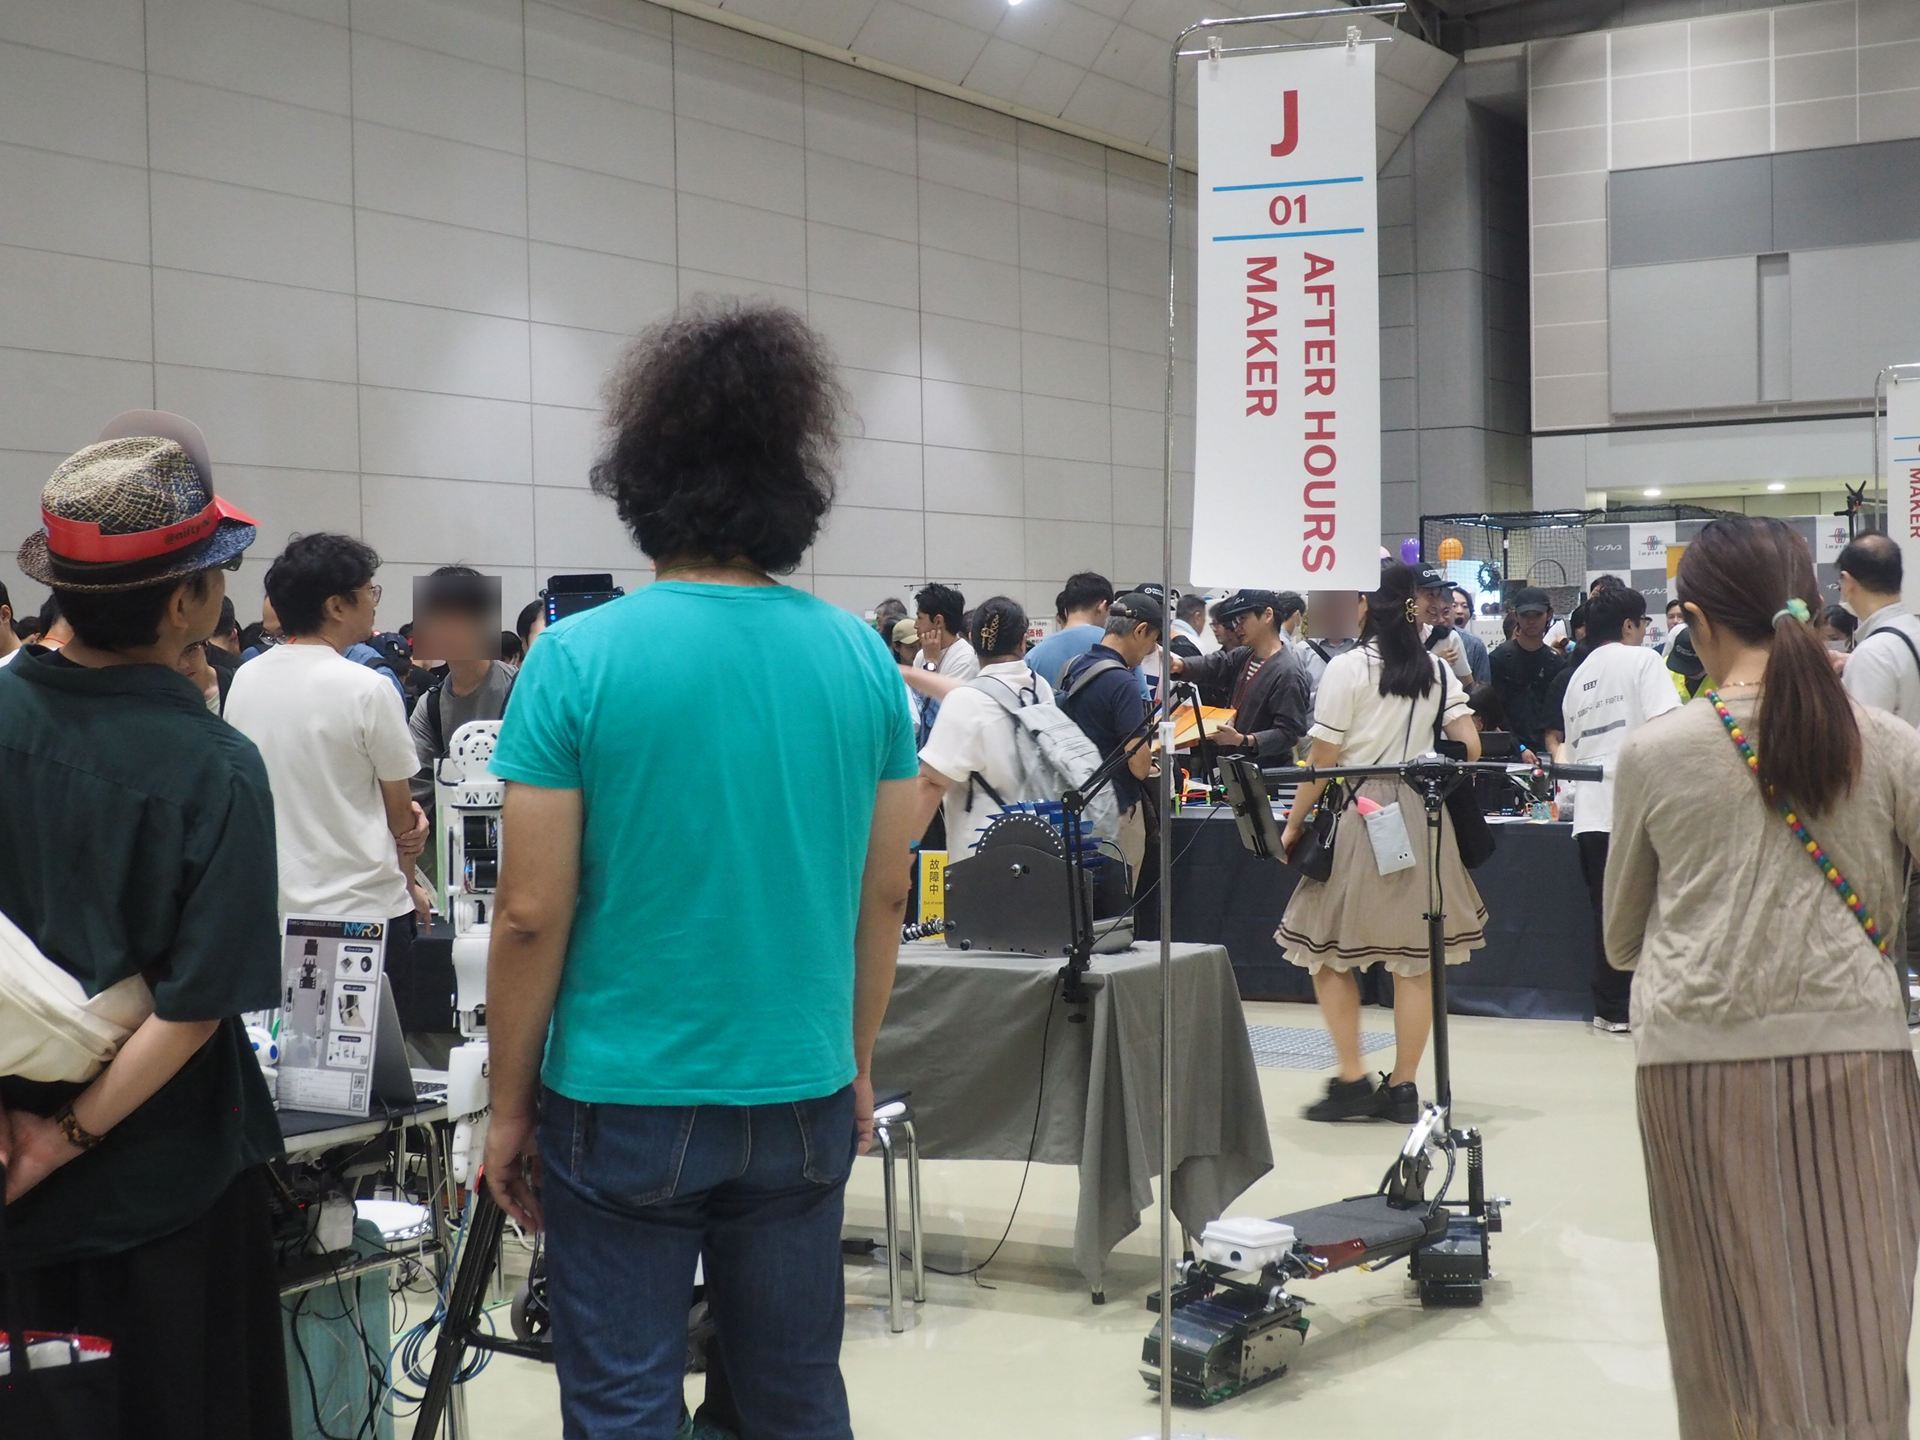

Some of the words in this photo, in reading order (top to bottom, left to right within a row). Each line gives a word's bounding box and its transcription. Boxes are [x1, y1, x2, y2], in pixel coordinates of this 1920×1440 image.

[1270, 90, 1299, 157] J
[1268, 194, 1307, 225] 01
[1246, 256, 1279, 417] MAKER
[1302, 252, 1336, 396] AFTER
[1302, 410, 1336, 573] HOURS
[1910, 469, 1920, 538] MAKER
[1593, 543, 1623, 552] インプレス
[929, 859, 940, 896] 故障中
